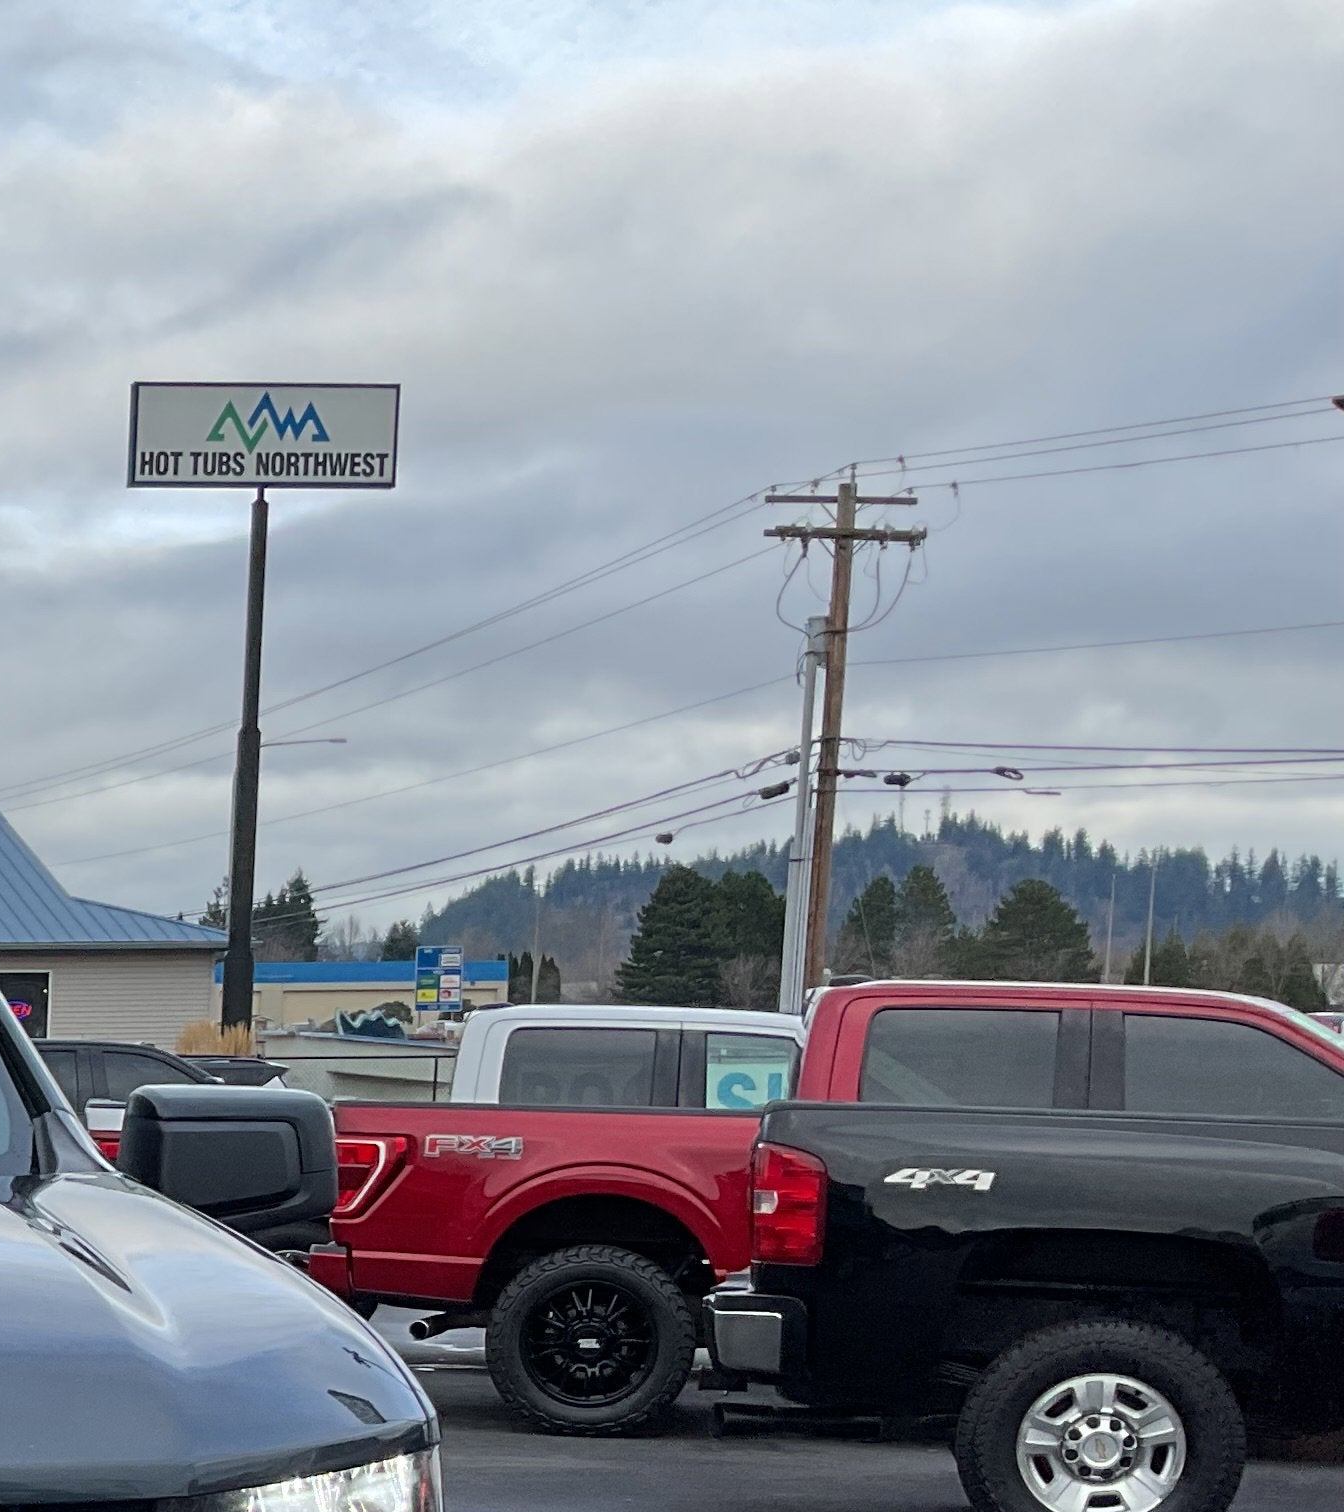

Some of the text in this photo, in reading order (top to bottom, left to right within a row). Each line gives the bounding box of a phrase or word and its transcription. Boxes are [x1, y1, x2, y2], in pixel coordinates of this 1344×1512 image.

[140, 451, 389, 477] HOT TUBS NORTHWEST
[9, 1004, 33, 1016] EN
[423, 1134, 523, 1157] FX4
